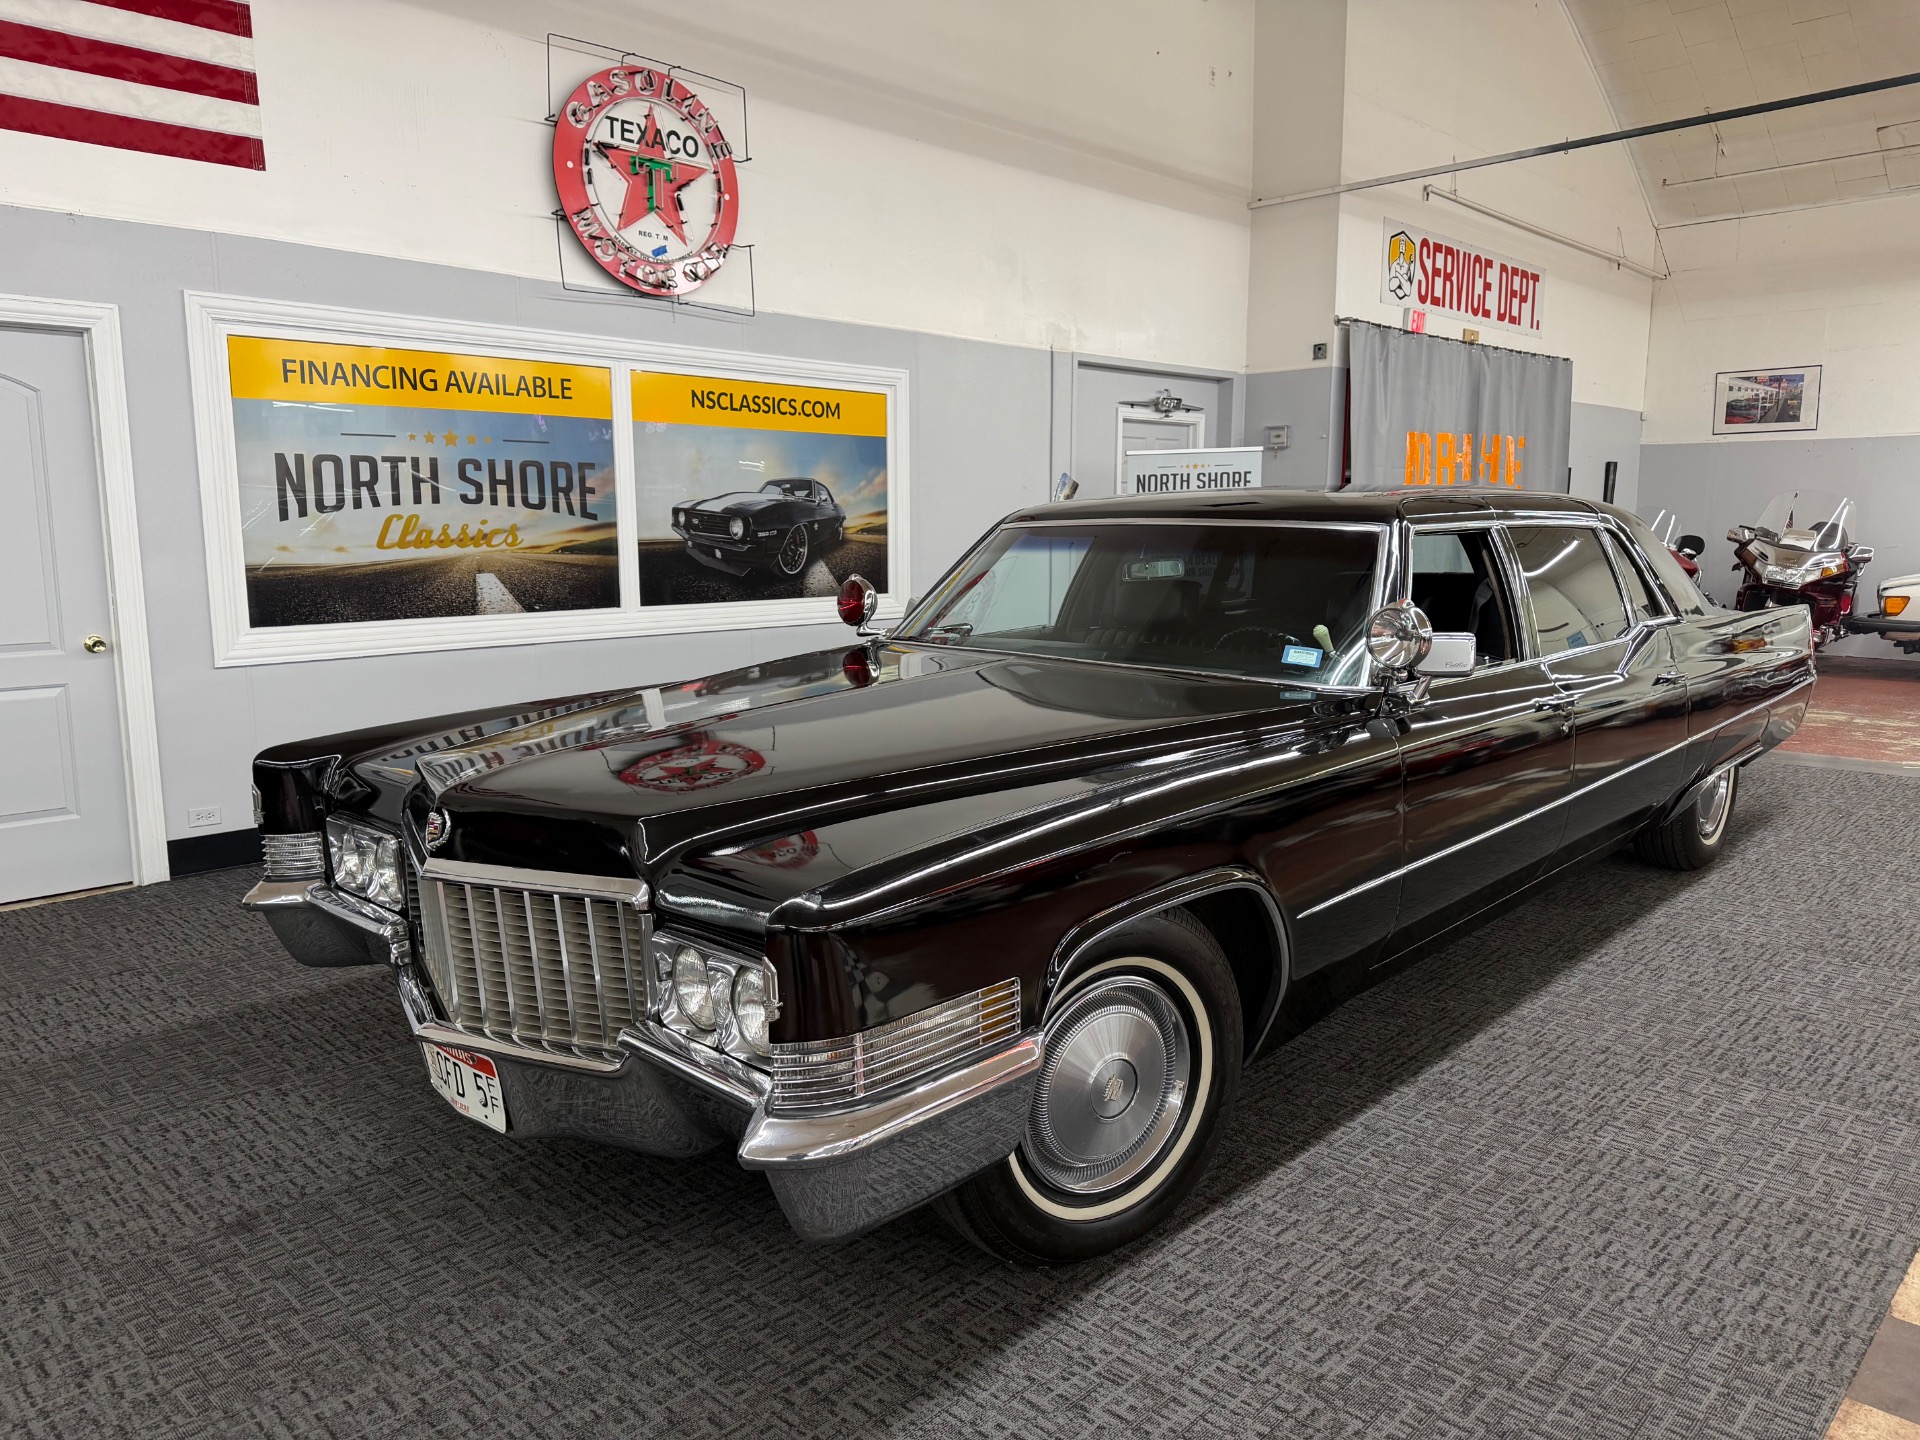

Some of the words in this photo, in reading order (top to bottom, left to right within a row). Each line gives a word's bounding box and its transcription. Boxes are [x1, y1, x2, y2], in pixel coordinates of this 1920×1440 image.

[566, 69, 733, 160] GASOLINE
[605, 115, 699, 158] TEXACO
[572, 207, 678, 289] MOTOR
[1417, 237, 1494, 319] SERVICE
[1496, 262, 1540, 331] DEPT.
[1411, 309, 1426, 333] EXIT
[281, 358, 438, 392] FINANCING
[445, 370, 573, 400] AVAILABLE
[690, 389, 841, 420] NSCLASSICS.COM
[274, 452, 440, 522] NORTH
[457, 458, 598, 521] SHORE
[1136, 473, 1190, 493] NORTH
[1196, 471, 1252, 489] SHORE
[376, 513, 525, 550] Classics
[436, 1051, 465, 1098] CFD
[473, 1071, 488, 1108] 5
